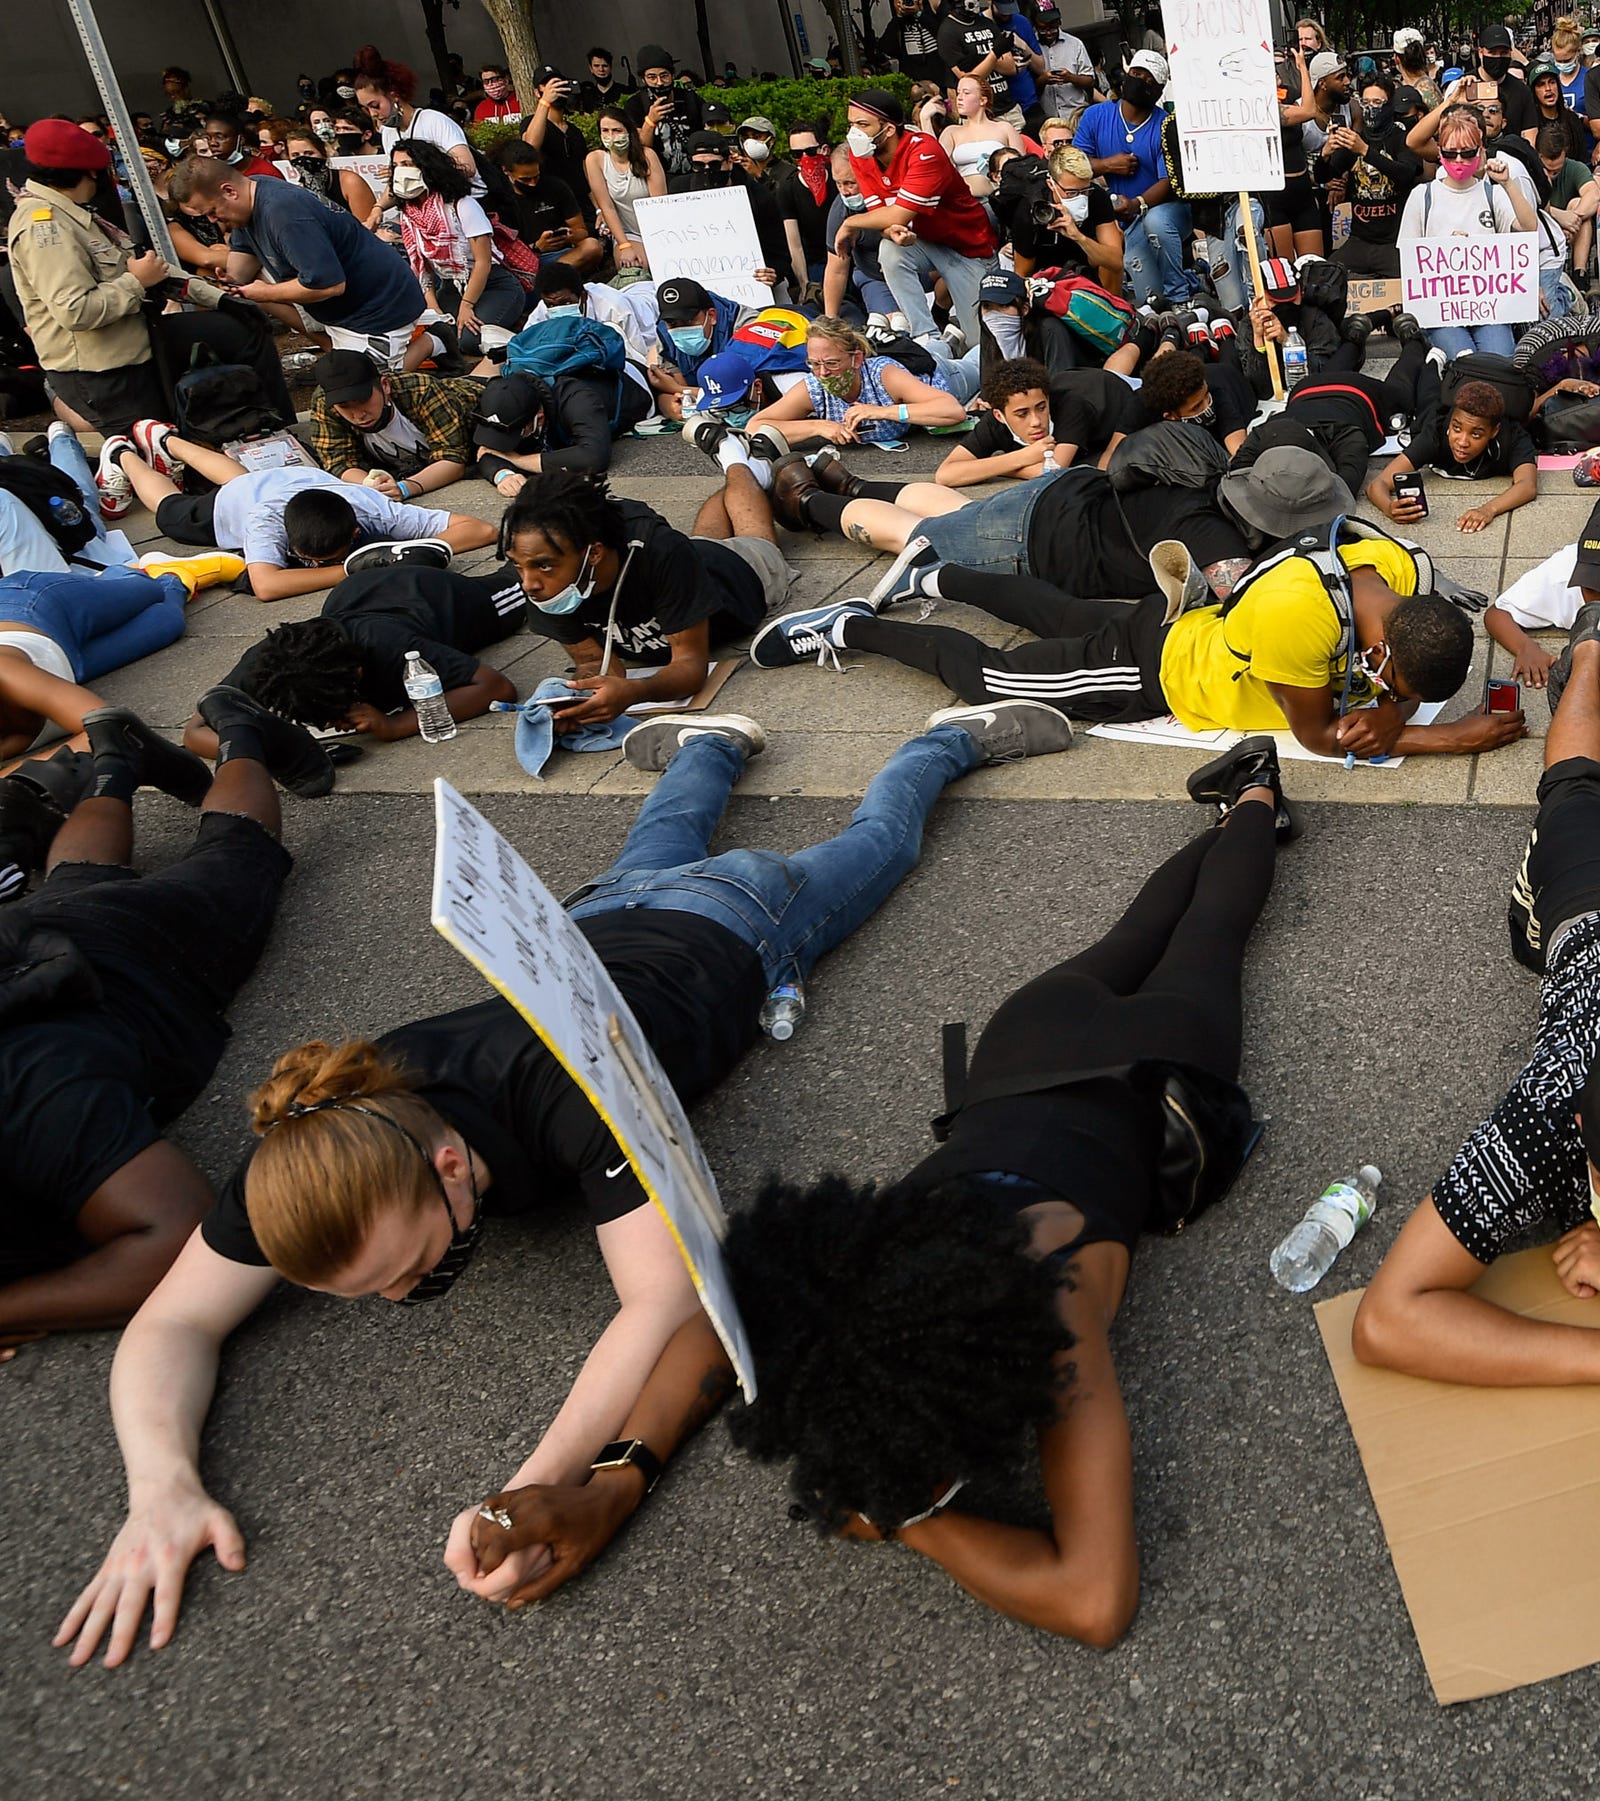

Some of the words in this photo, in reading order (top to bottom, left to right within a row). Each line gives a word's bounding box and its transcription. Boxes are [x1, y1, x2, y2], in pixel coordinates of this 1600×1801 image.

[1188, 98, 1236, 129] LITTLE
[1239, 95, 1278, 129] DICK
[1353, 203, 1396, 223] QUEEN
[1416, 245, 1500, 274] RACISM
[1510, 243, 1529, 270] IS
[1407, 275, 1470, 300] LITTLE
[1472, 272, 1527, 297] DICK
[1440, 298, 1498, 322] ENERGY
[704, 375, 723, 394] LA
